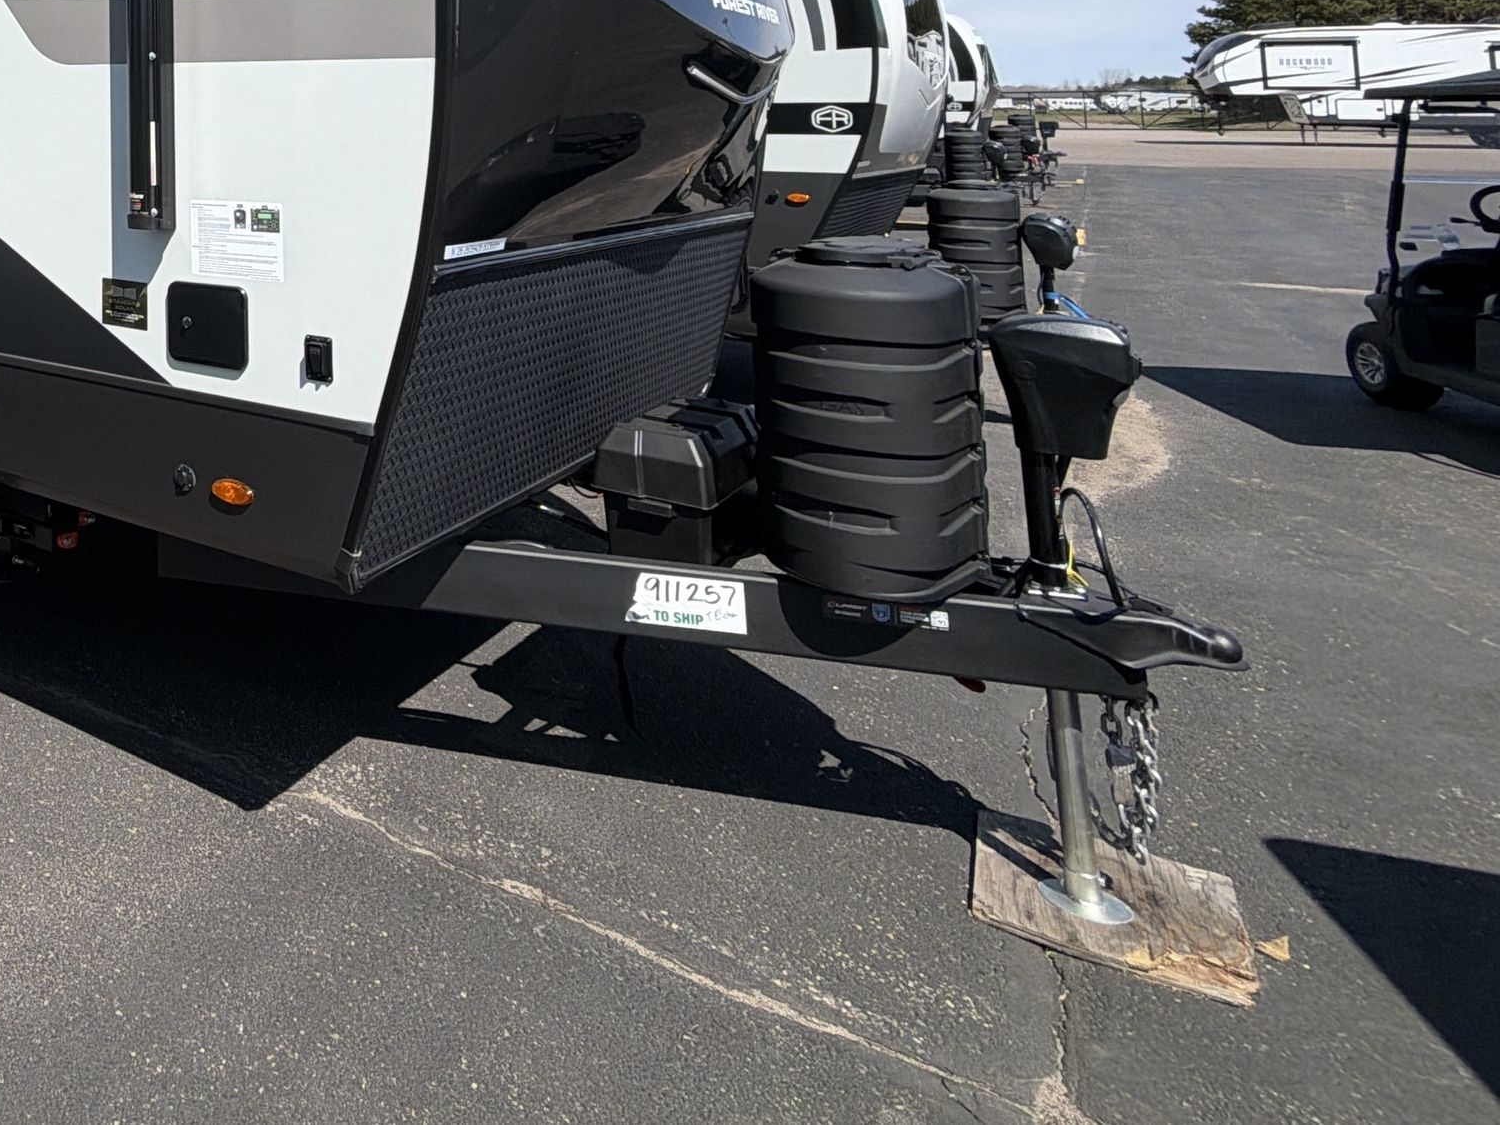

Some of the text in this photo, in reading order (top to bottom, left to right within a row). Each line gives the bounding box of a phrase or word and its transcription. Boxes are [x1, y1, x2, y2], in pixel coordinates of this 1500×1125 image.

[754, 1, 781, 25] RIVER
[643, 576, 737, 607] 911257
[653, 609, 670, 623] TO
[673, 611, 705, 626] SHIP
